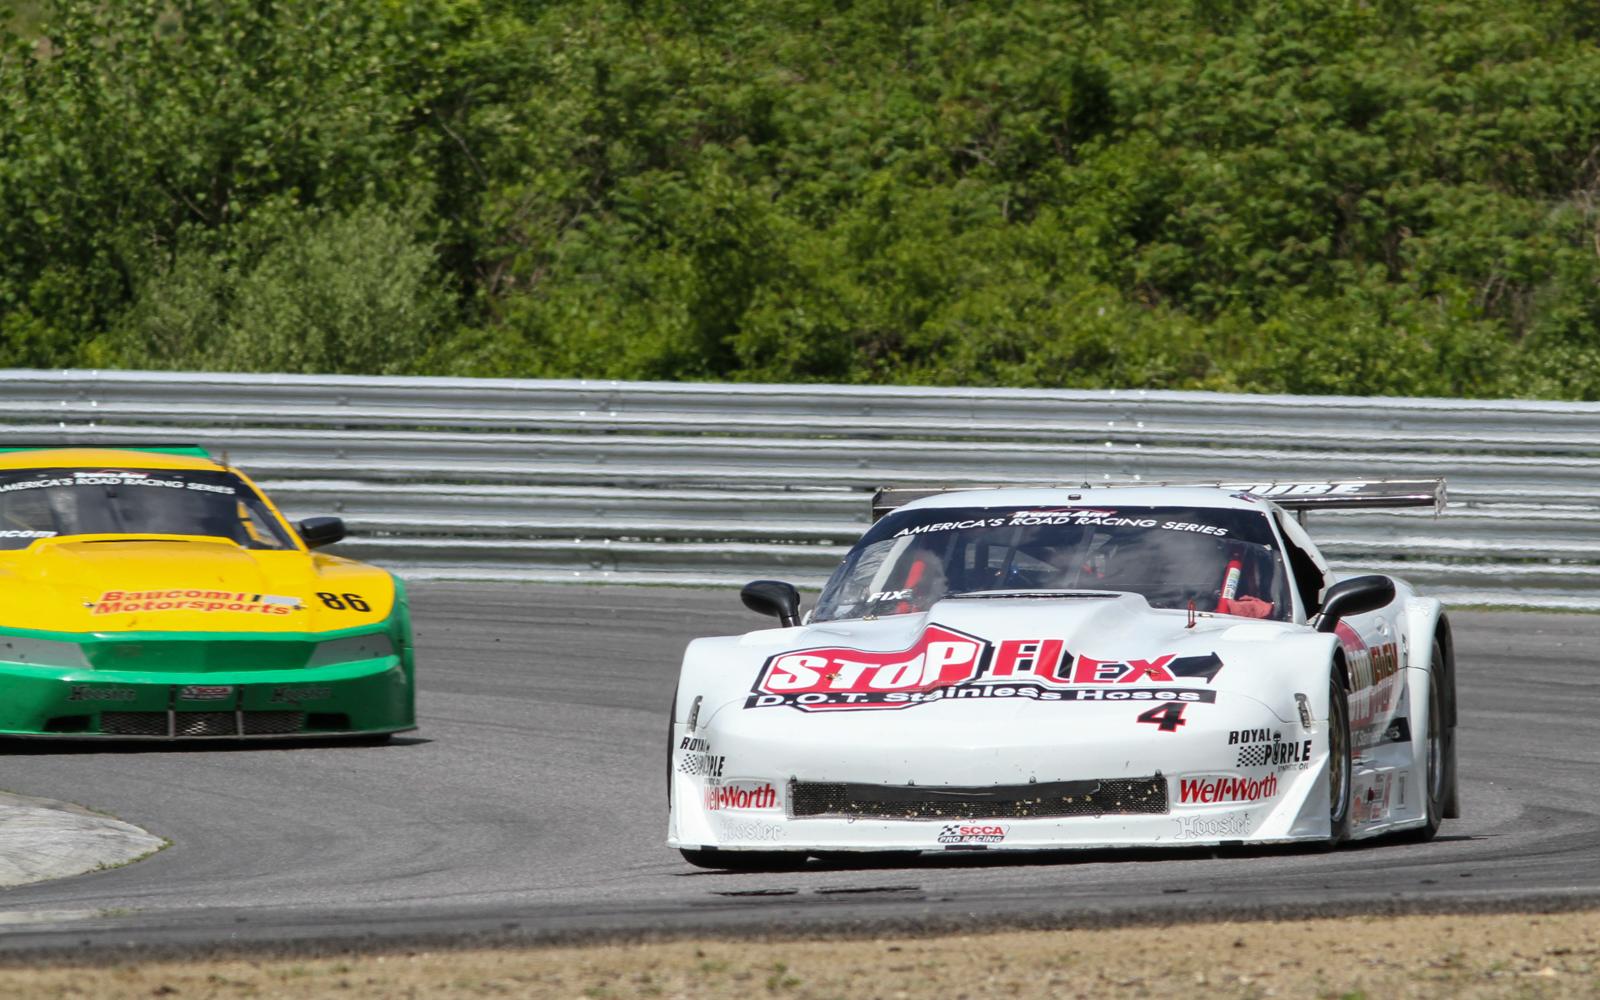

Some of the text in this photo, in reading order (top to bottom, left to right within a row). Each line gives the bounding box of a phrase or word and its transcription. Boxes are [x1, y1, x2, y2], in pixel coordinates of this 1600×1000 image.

[76, 478, 120, 486] ROAD
[123, 478, 184, 489] RACING
[187, 482, 235, 495] SERIES
[893, 517, 1228, 538] AMERICA'S ROAD RACING SERIES
[102, 590, 231, 602] Baucom
[315, 592, 372, 613] 86
[866, 591, 908, 602] FIX
[94, 599, 289, 615] Motorsports
[755, 685, 1200, 706] D.O.T. Stainless Hoses
[1136, 702, 1188, 732] 4
[1228, 728, 1271, 745] ROYAL
[1264, 740, 1312, 765] PURPLE
[960, 826, 1004, 835] SCCA
